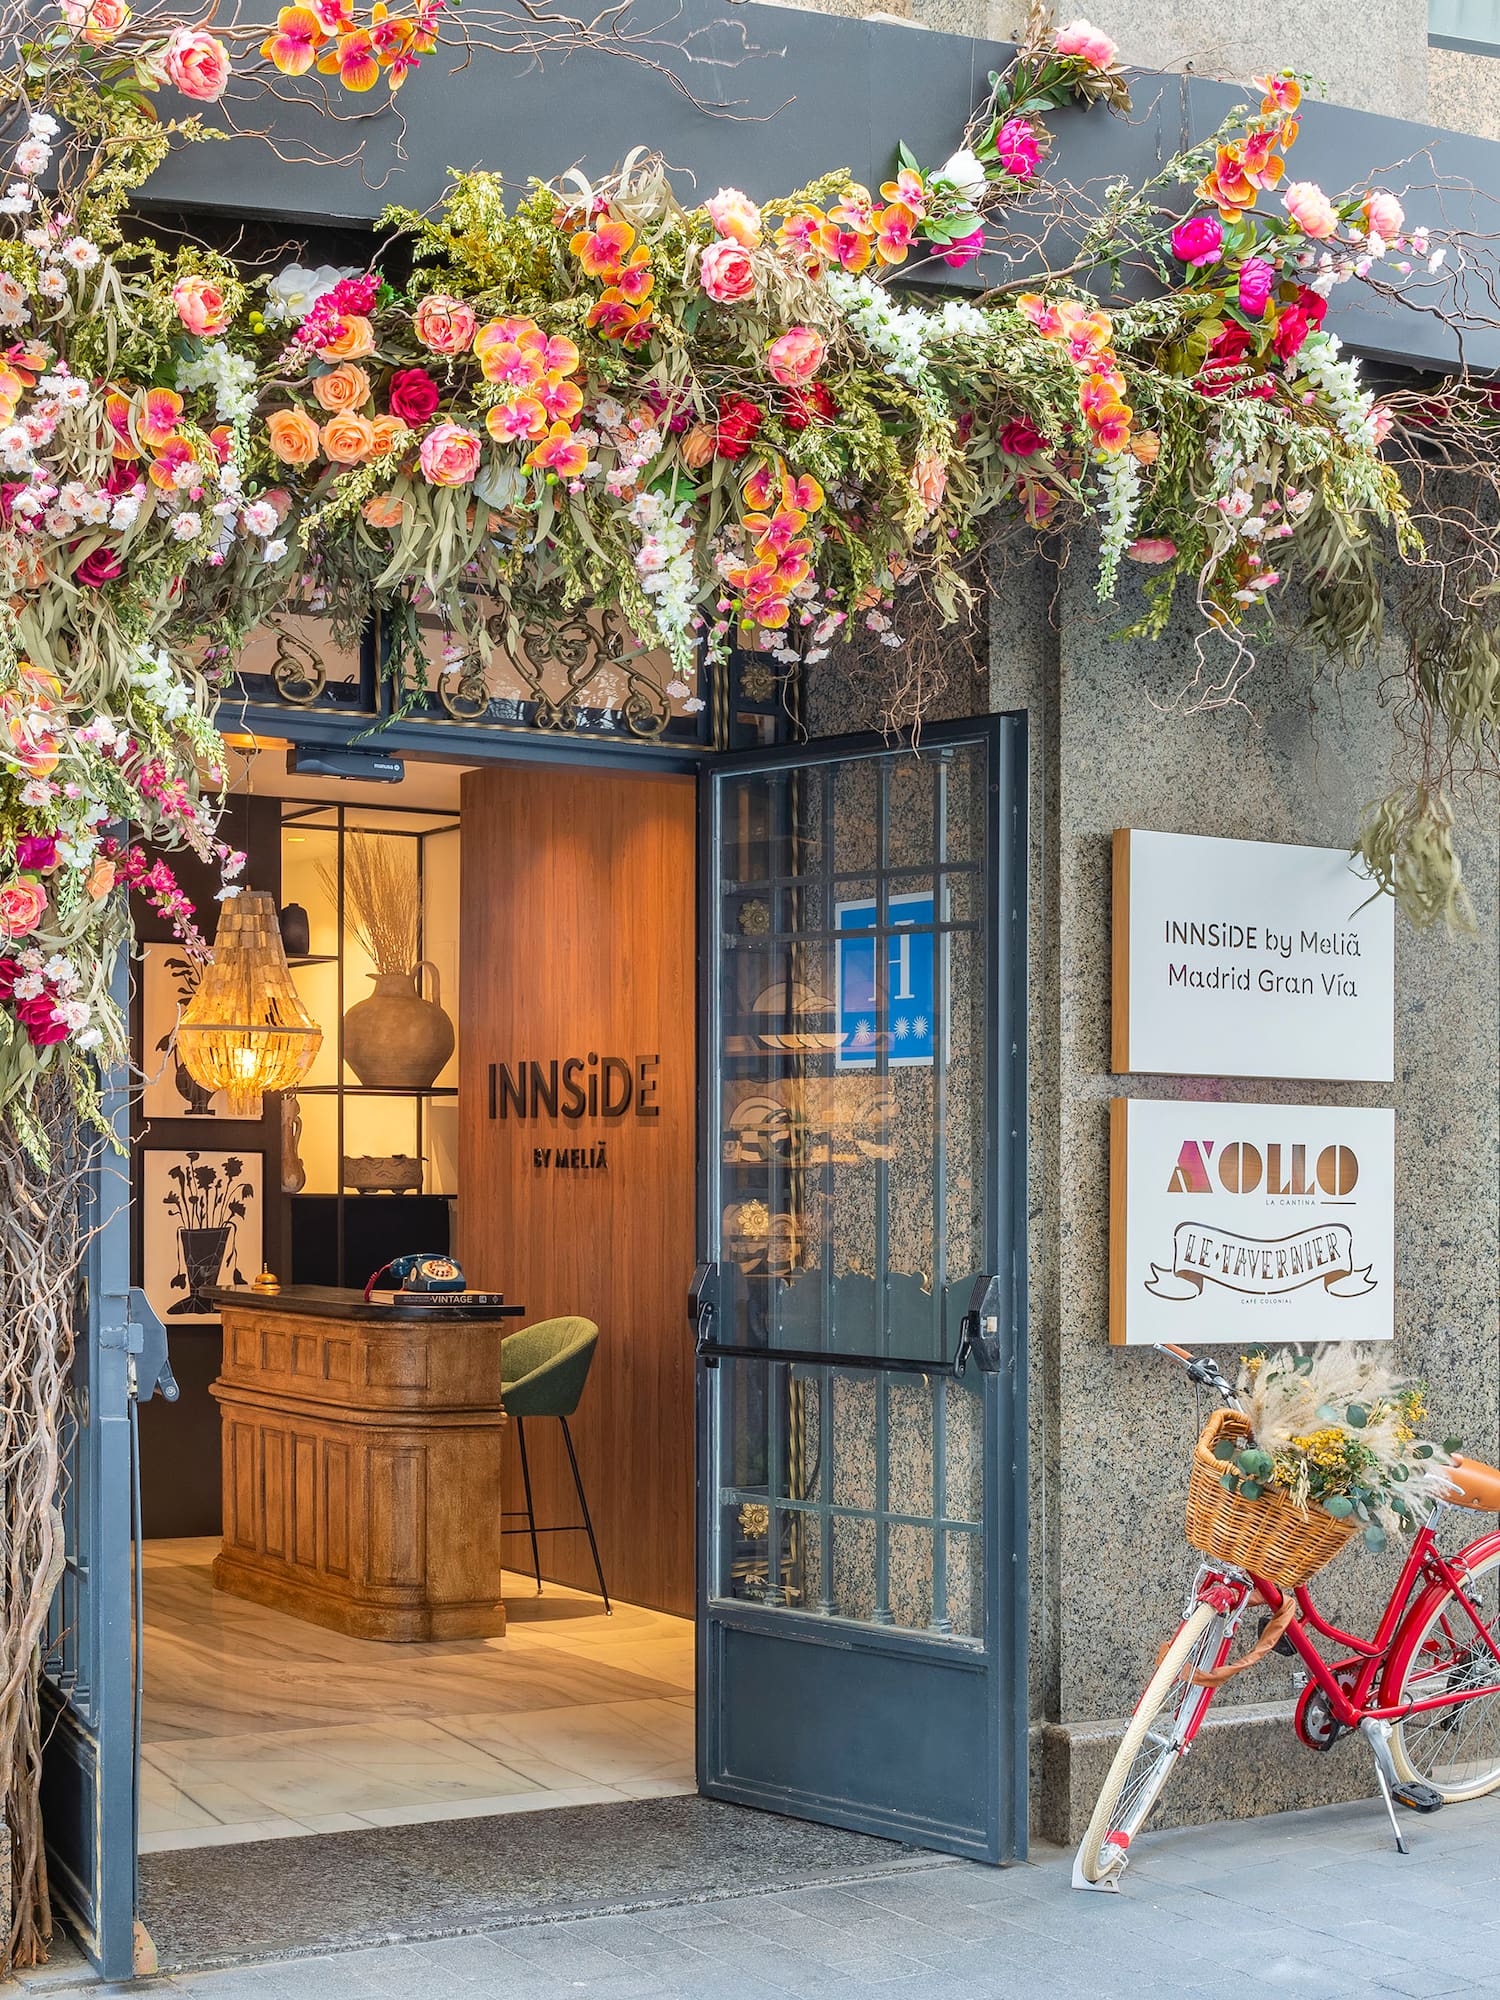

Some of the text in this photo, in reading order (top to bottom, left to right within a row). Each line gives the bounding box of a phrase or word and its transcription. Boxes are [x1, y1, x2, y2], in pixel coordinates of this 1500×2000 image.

[1165, 920, 1258, 949] INNSiDE
[1265, 928, 1292, 958] by
[1168, 963, 1358, 997] Madrid Gran Vía
[533, 1148, 551, 1168] BY
[431, 1295, 473, 1304] VINTAGE
